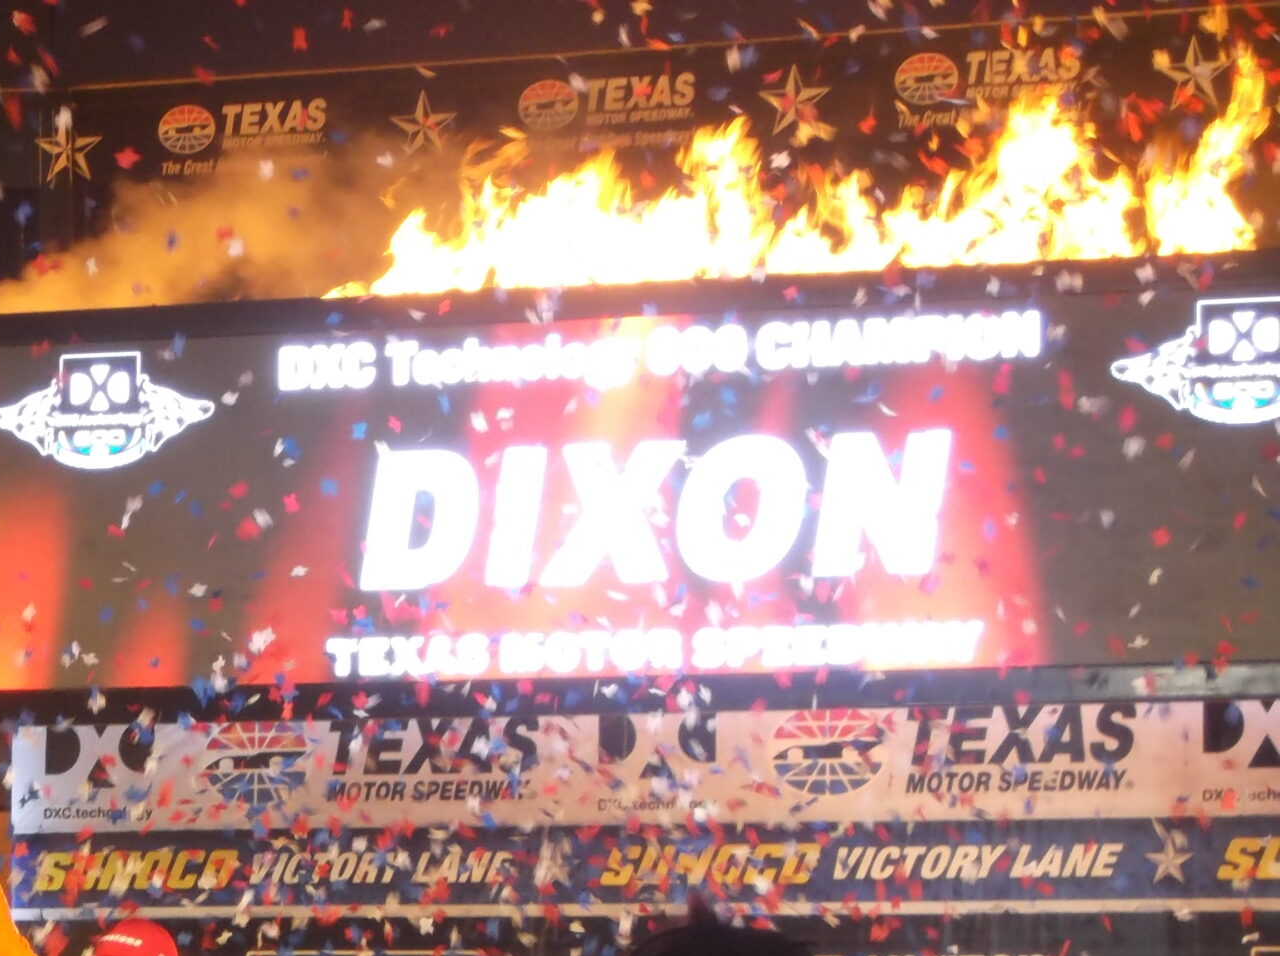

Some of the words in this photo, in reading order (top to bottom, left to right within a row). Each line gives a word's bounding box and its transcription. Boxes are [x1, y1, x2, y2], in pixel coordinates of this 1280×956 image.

[966, 47, 1081, 85] TEXAS
[585, 72, 695, 112] TEXAS
[222, 97, 327, 137] TEXAS
[277, 340, 376, 391] DXC
[754, 309, 1042, 371] CHAMPION
[360, 428, 953, 592] DIXON
[326, 632, 490, 678] TEXAS
[498, 628, 683, 674] MOTOR
[692, 619, 985, 669] SPEEDWAY
[329, 712, 542, 776] TEXAS
[906, 702, 1137, 766] TEXAS
[327, 780, 408, 802] MOTOR
[905, 772, 991, 794] MOTOR
[249, 850, 403, 885] VICTORY
[832, 845, 1007, 880] VICTORY
[1009, 843, 1124, 878] LANE
